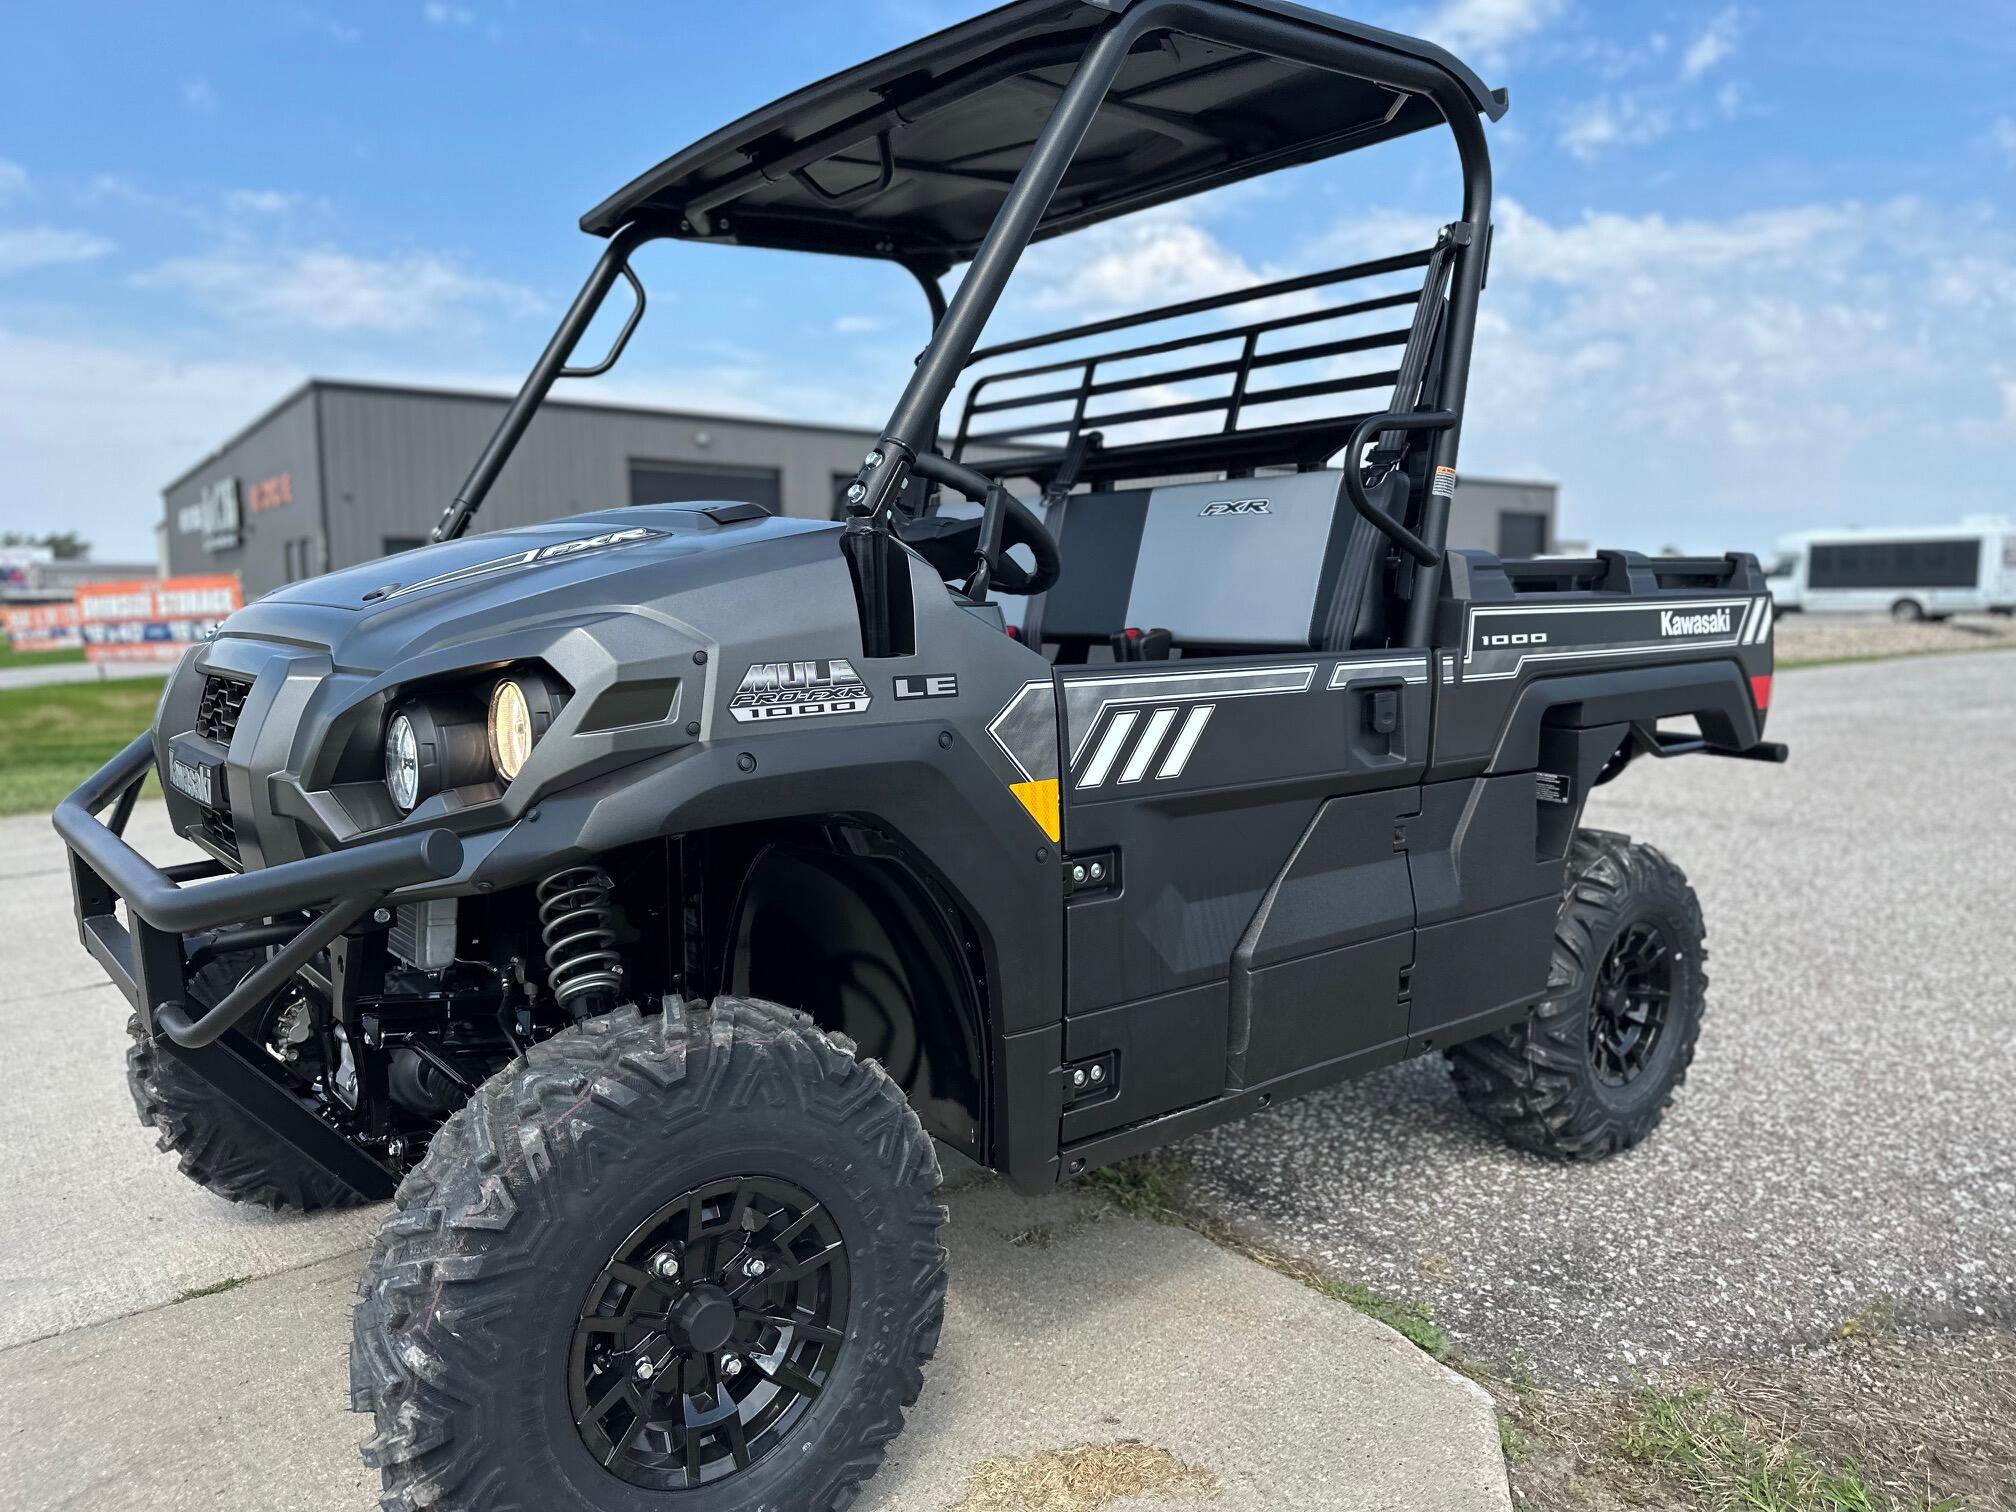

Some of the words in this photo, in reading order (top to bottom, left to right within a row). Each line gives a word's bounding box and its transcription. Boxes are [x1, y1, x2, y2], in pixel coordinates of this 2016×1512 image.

[1199, 498, 1272, 516] FXR
[537, 527, 658, 560] FXR
[1661, 608, 1731, 636] Kawasaki
[1481, 632, 1548, 646] 1000
[736, 659, 865, 694] MULE
[896, 676, 957, 698] LE
[729, 685, 868, 707] PRO-FXR
[749, 701, 857, 719] 1000
[168, 748, 212, 805] Kawasaki
